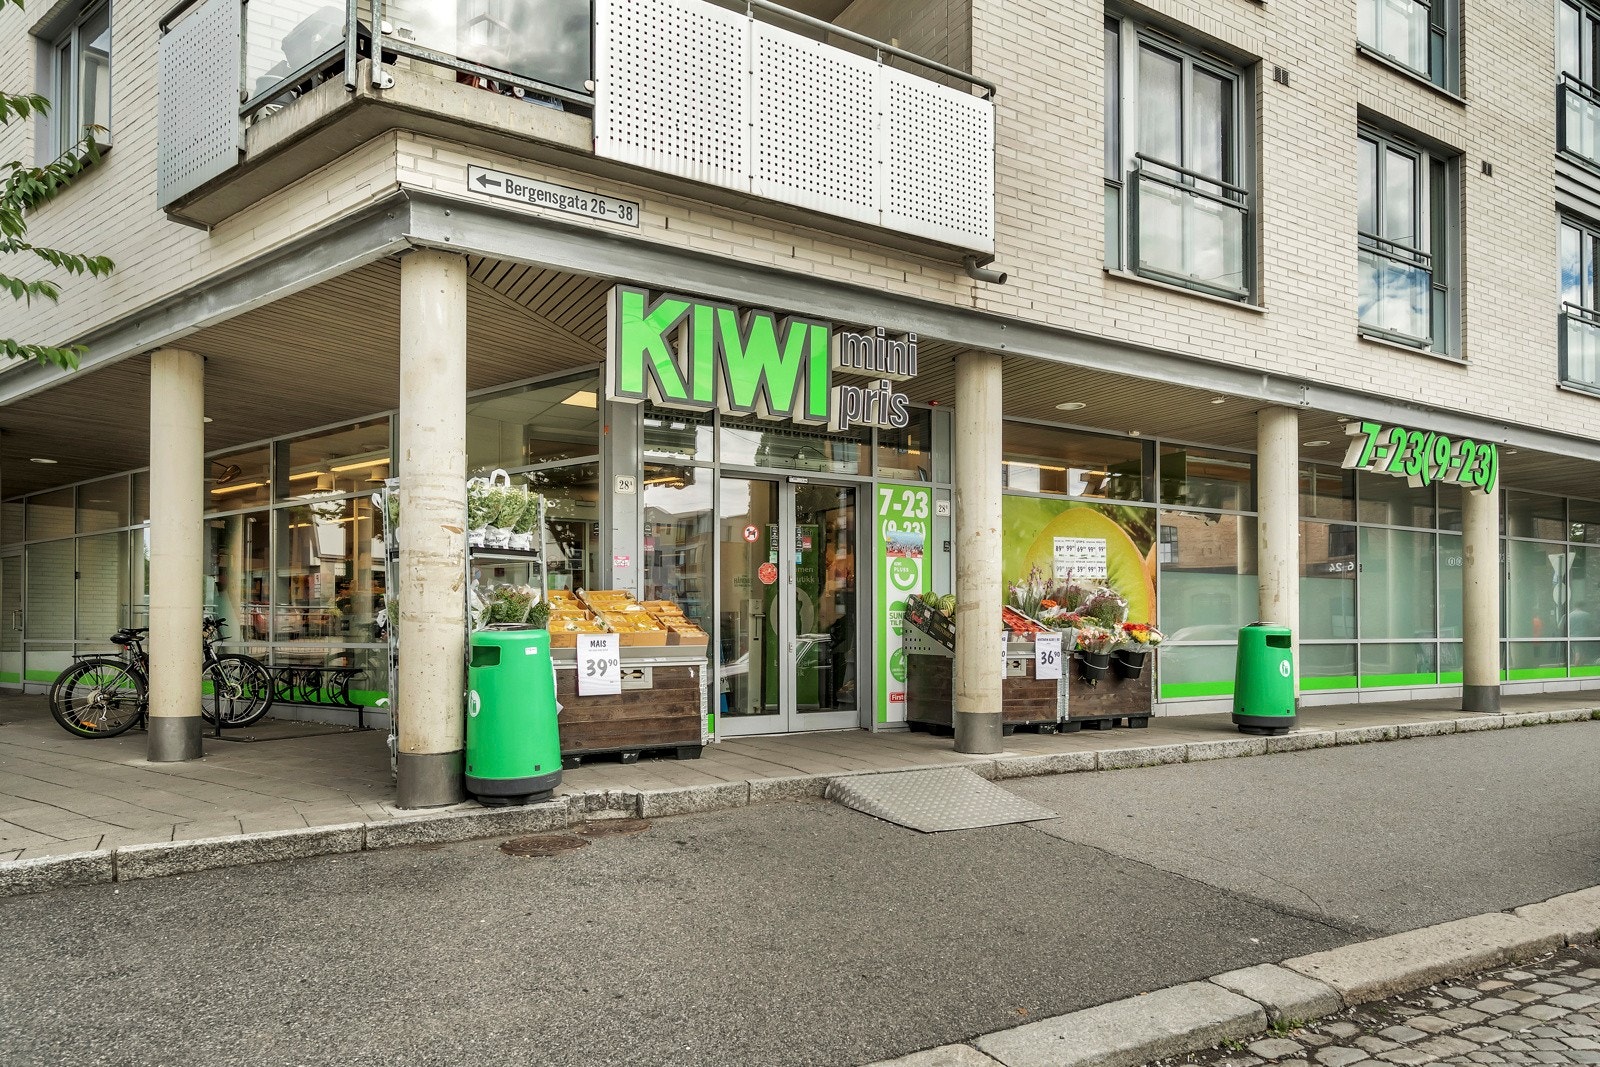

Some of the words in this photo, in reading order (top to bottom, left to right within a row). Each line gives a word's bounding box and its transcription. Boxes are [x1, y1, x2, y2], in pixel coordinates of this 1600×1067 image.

[505, 178, 588, 211] Bergensgata
[616, 285, 832, 422] KIWI
[840, 326, 918, 377] mini
[839, 379, 910, 431] pris
[879, 488, 929, 519] 7-23
[590, 640, 607, 648] MAIS
